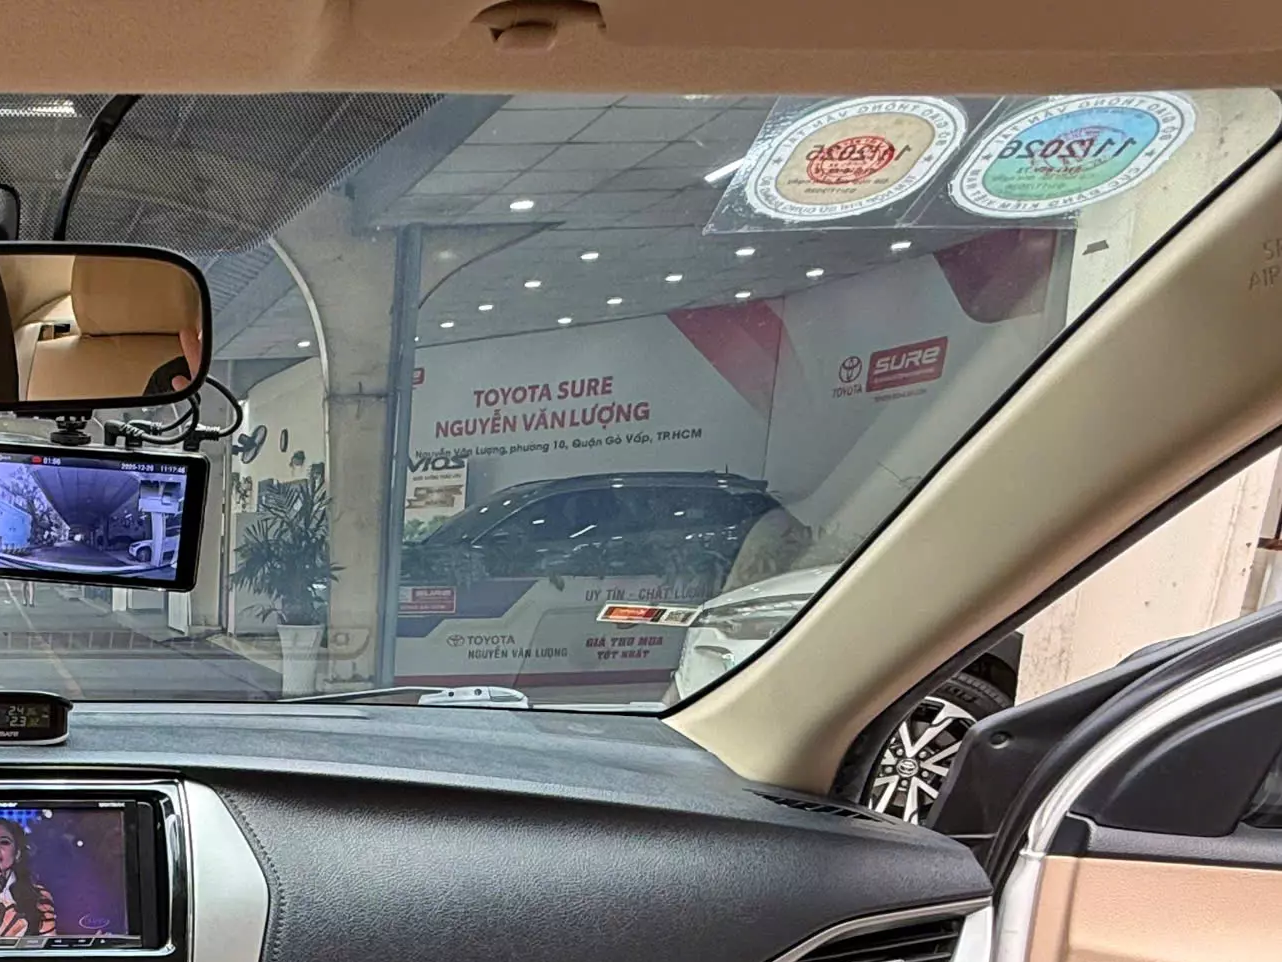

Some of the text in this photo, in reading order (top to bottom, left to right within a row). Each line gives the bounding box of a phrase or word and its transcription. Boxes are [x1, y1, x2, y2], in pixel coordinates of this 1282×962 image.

[873, 346, 941, 376] SURE
[473, 376, 613, 408] TOYOTA SURE
[832, 384, 863, 398] TOYOTA
[435, 402, 650, 438] NGUYỄN VĂN LƯỢNG
[509, 441, 550, 455] phường
[573, 436, 603, 449] Quận
[605, 433, 622, 445] Gò
[625, 432, 653, 446] Vấp,
[407, 455, 469, 473] VIOS
[585, 590, 602, 601] UY
[606, 586, 626, 600] TÍN
[467, 635, 515, 645] TOYOTA
[468, 645, 508, 659] NGUYỄN
